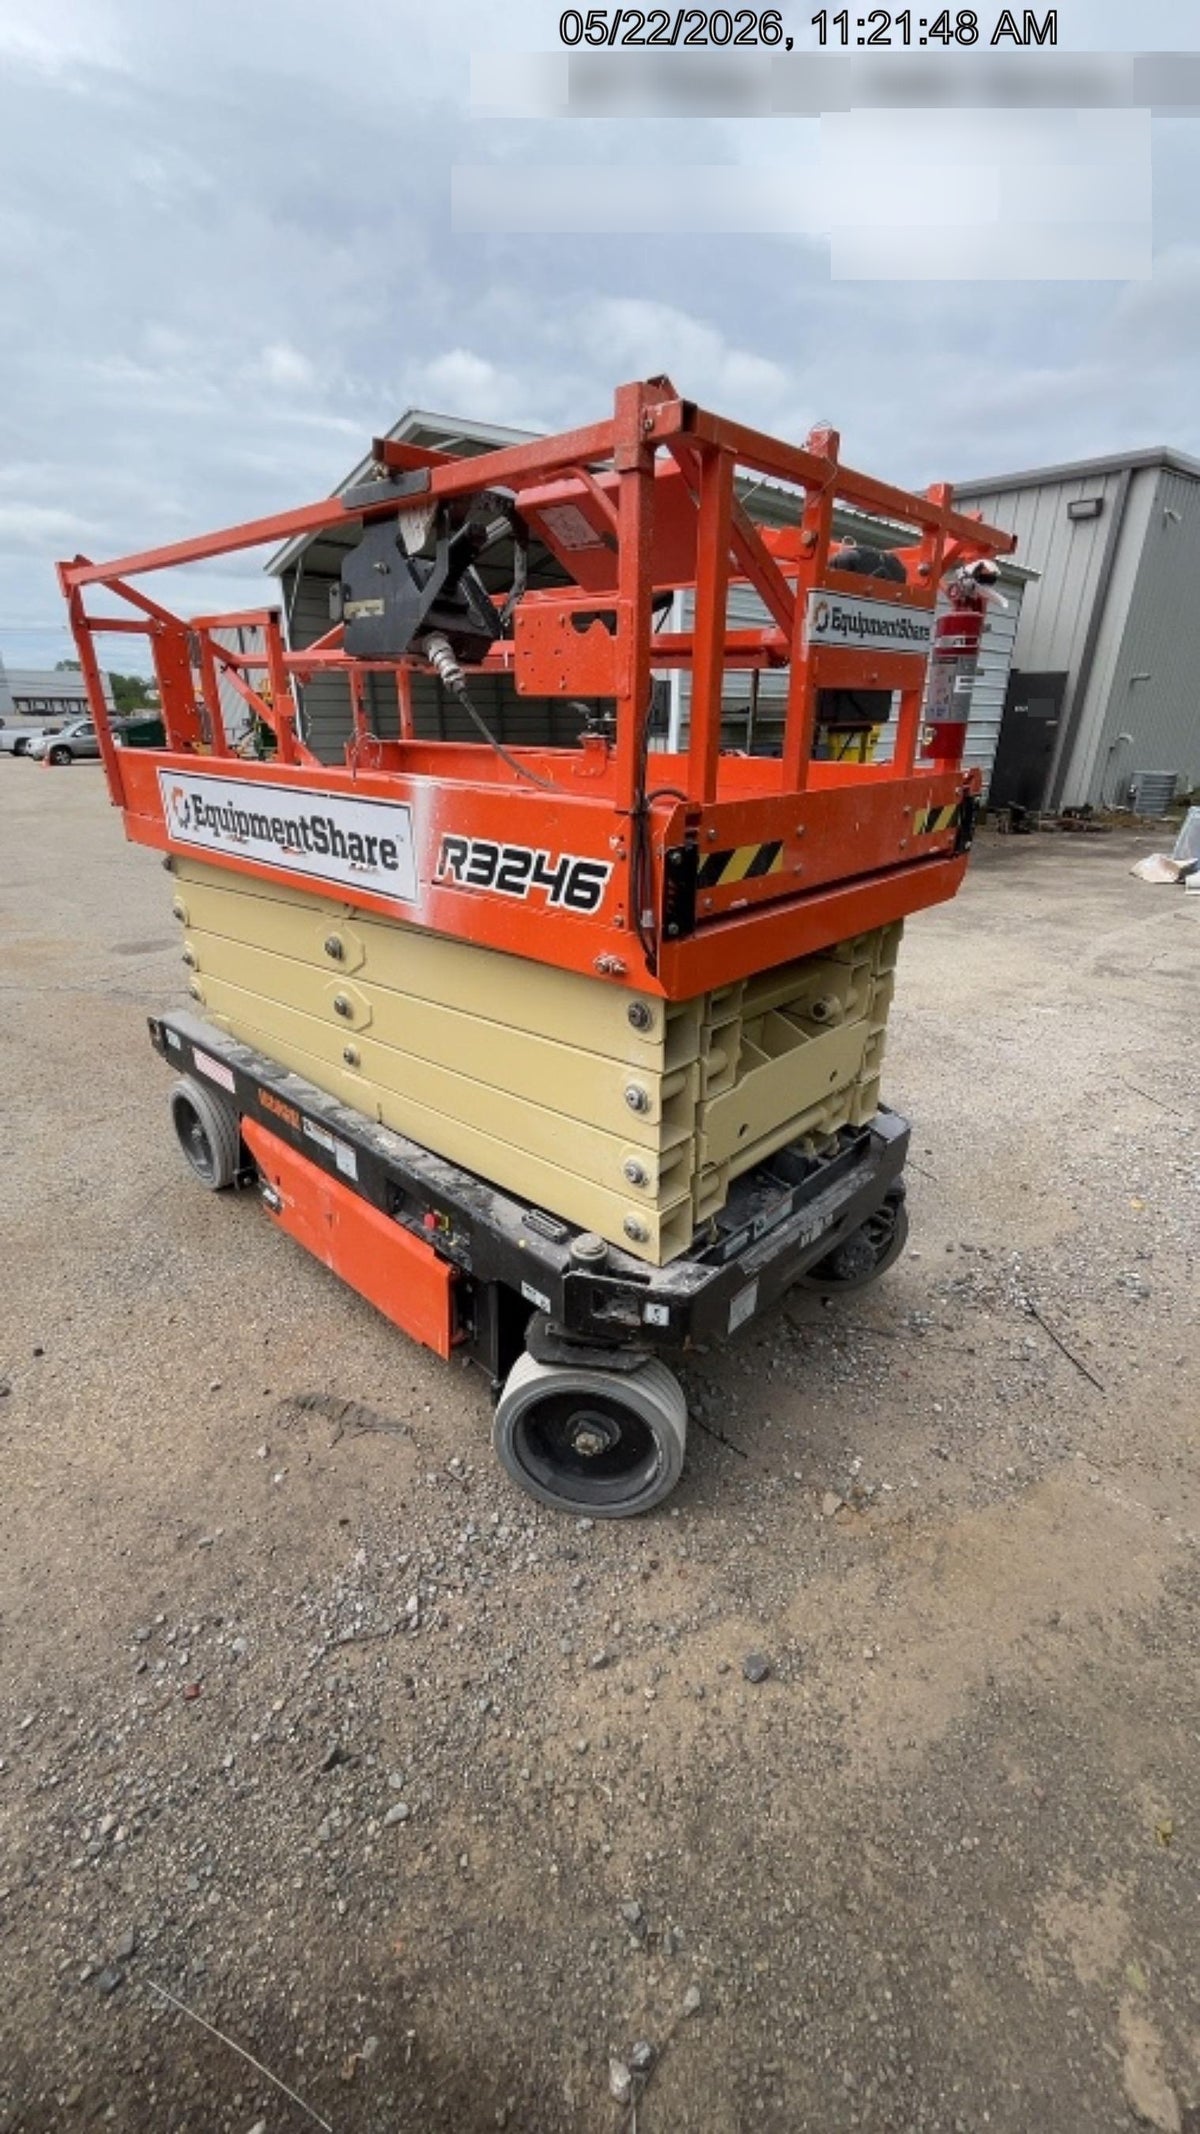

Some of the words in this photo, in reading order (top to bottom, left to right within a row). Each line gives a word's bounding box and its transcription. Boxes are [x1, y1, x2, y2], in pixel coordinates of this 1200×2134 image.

[832, 606, 931, 640] EquipmentShare
[190, 794, 399, 871] EquipmentShare
[437, 834, 611, 912] R3246
